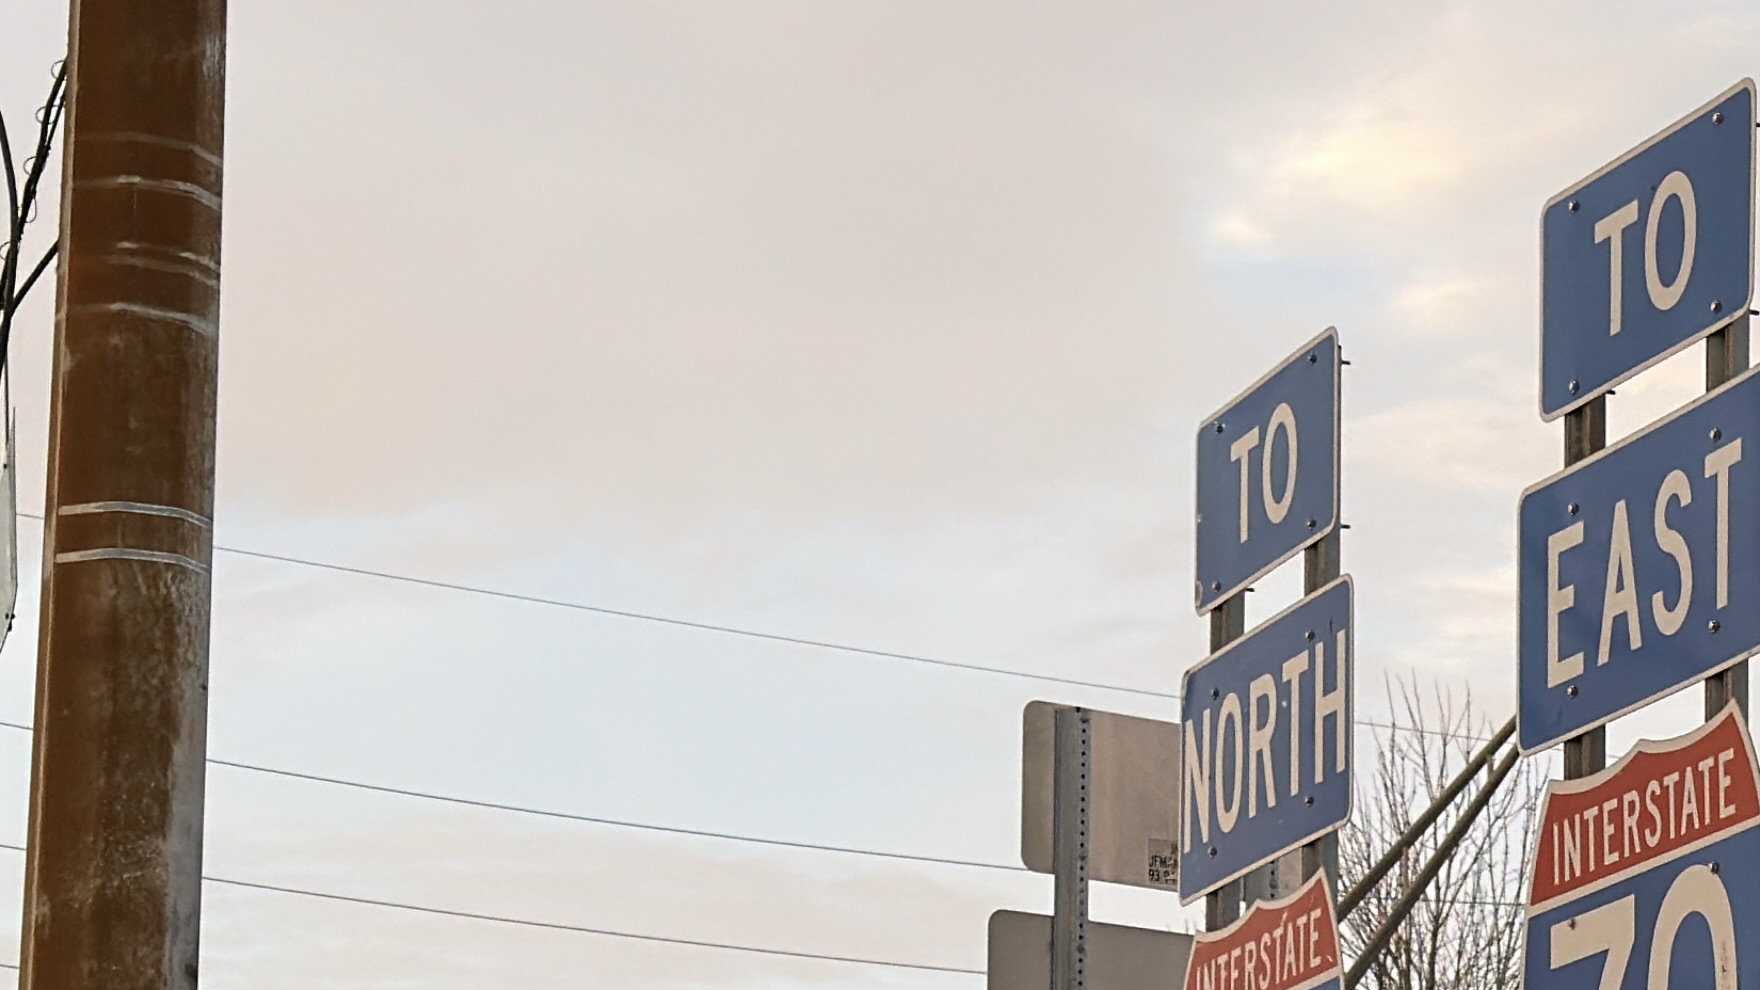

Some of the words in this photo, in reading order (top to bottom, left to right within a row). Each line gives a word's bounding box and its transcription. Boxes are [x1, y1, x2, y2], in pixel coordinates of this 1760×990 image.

[1595, 171, 1697, 336] TO
[1230, 402, 1298, 544] TO
[1547, 437, 1742, 689] EAST
[1183, 629, 1345, 854] NORTH
[1553, 748, 1737, 886] INTERSTATE
